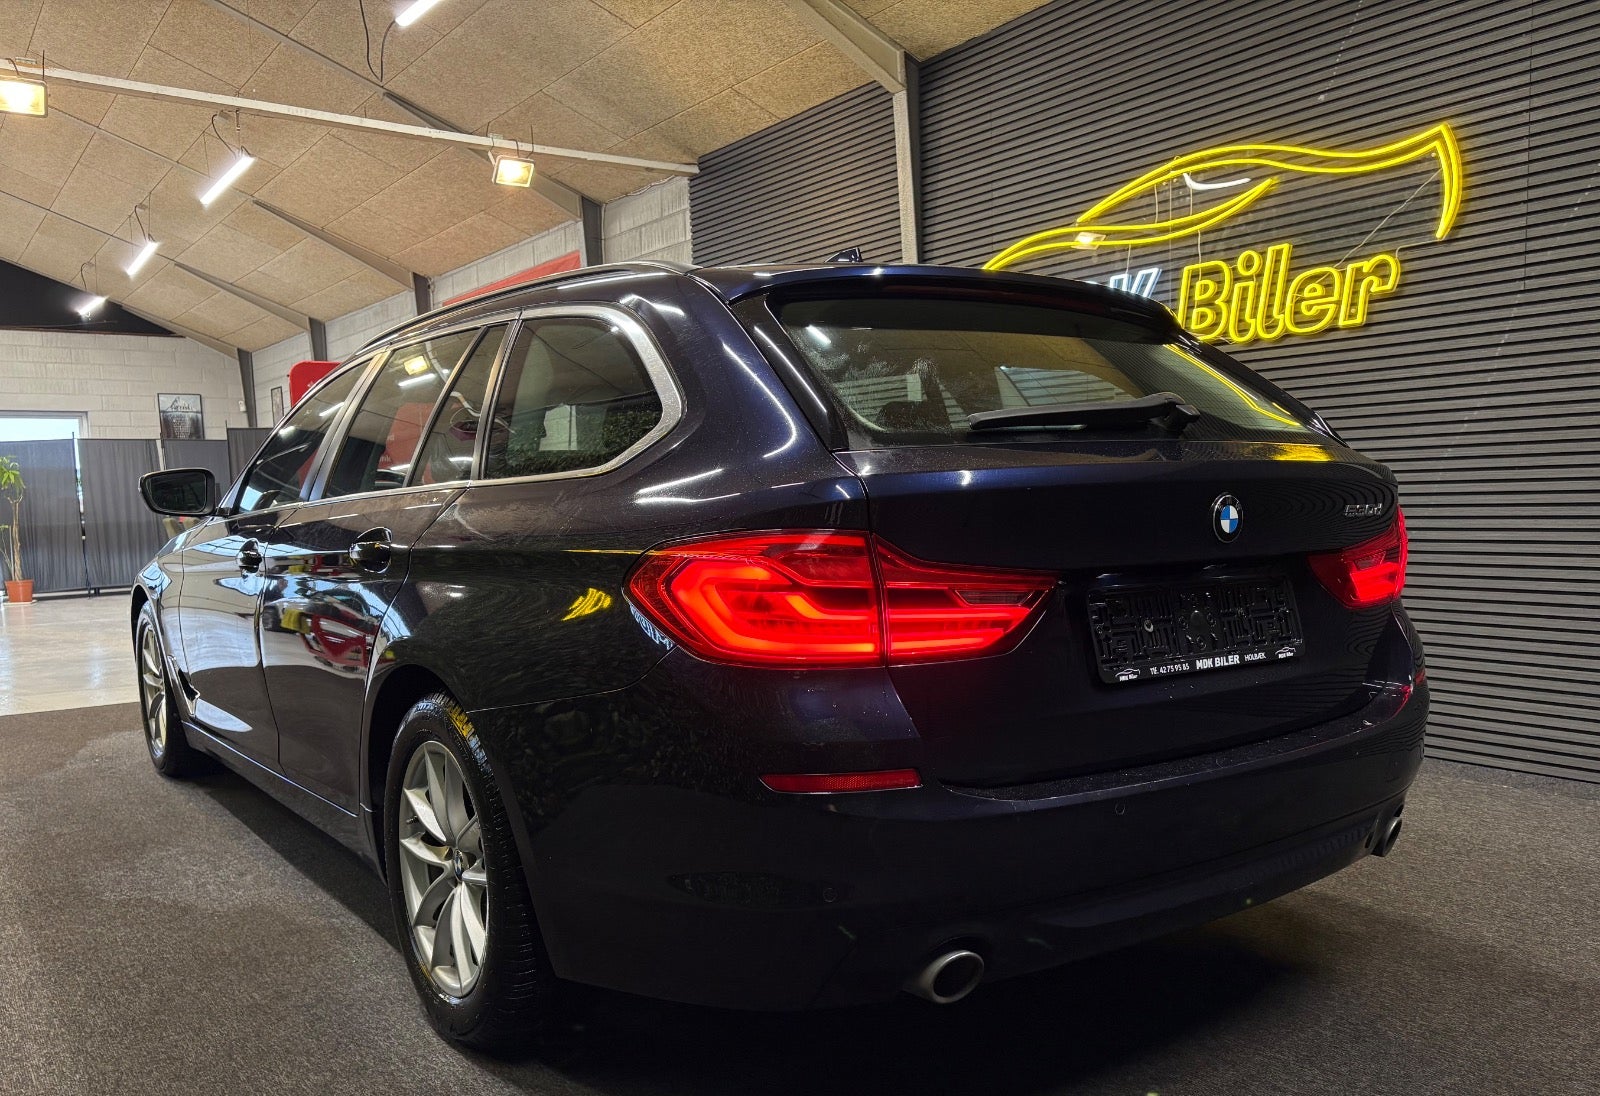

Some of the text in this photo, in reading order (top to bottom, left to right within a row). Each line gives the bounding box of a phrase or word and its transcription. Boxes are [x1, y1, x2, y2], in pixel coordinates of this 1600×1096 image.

[1178, 243, 1400, 343] Biler
[1196, 658, 1214, 670] MDK
[1214, 654, 1241, 668] BILER
